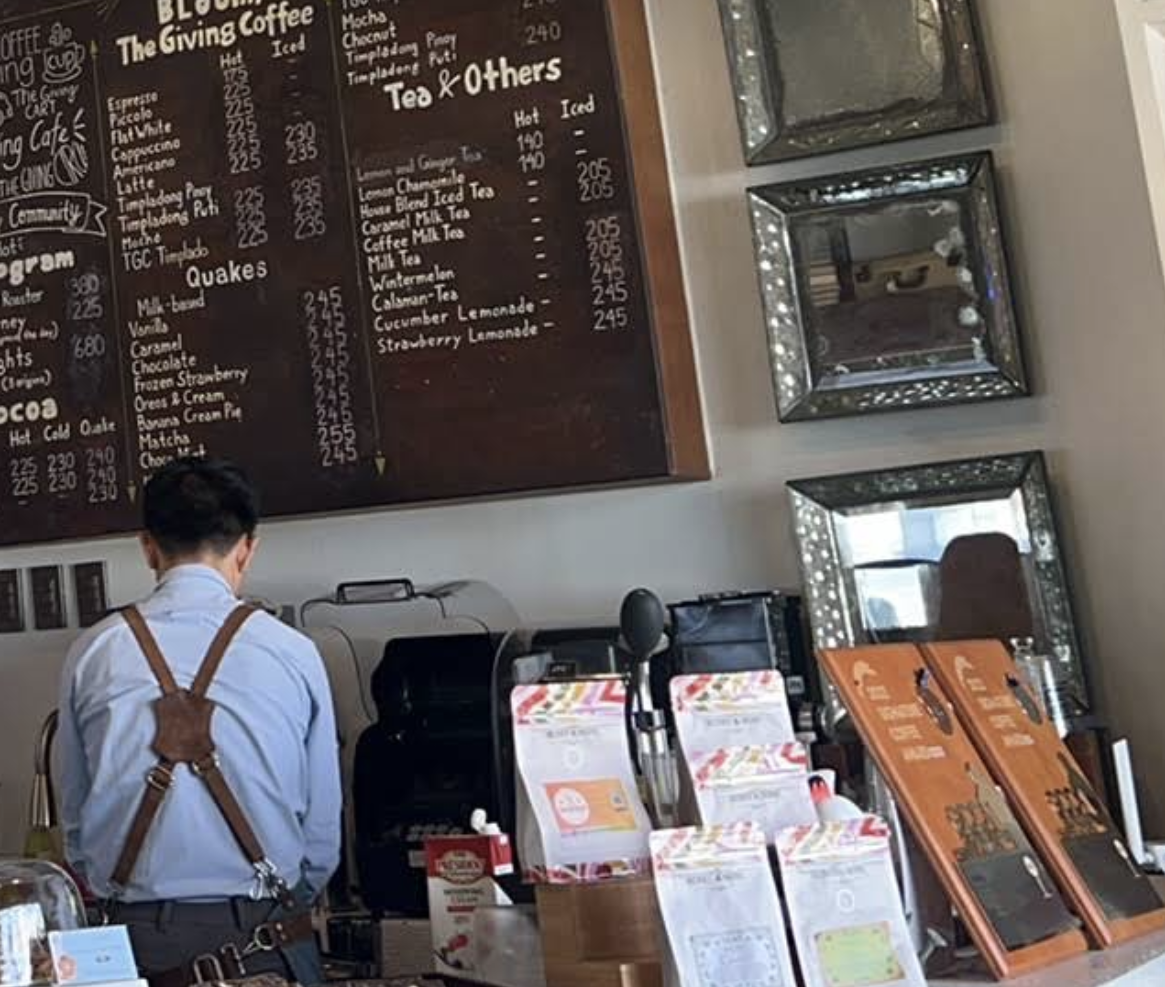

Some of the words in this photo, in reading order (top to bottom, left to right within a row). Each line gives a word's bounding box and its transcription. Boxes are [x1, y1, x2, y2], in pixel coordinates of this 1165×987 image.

[343, 10, 387, 30] Mocha
[116, 35, 157, 66] The
[158, 21, 236, 54] Giving
[239, 1, 313, 36] Coffee
[527, 22, 561, 44] 240
[271, 33, 306, 58] Iced
[384, 81, 432, 110] Tea
[465, 57, 561, 95] Others
[108, 91, 158, 113] Espresso
[514, 107, 539, 129] Hot
[561, 97, 595, 119] Iced
[30, 112, 70, 155] Cafe
[135, 120, 171, 138] White
[113, 158, 176, 180] Americano
[117, 177, 154, 195] Latte
[396, 194, 429, 213] Blend
[434, 189, 464, 207] Iced
[469, 182, 494, 199] Tea
[9, 200, 82, 228] Community
[362, 215, 410, 236] Caramel
[415, 209, 443, 226] Milk
[447, 205, 470, 221] Tea
[363, 237, 408, 253] Coffee
[412, 228, 439, 245] Milk
[444, 224, 465, 240] Tea
[123, 249, 152, 270] TGC
[368, 255, 395, 273] Milk
[399, 251, 421, 267] Tea
[186, 260, 267, 288] Quakes
[369, 264, 455, 293] Wintermelon
[374, 311, 449, 332] Cucumber
[458, 296, 534, 322] Lemonade
[129, 317, 168, 338] Vanilla
[378, 333, 461, 354] Strawberry
[468, 319, 537, 343] Lemonade
[131, 334, 182, 358] Caramel
[132, 352, 196, 375] Chocolate
[135, 377, 174, 393] Frozen
[177, 365, 248, 387] Strawberry
[184, 390, 225, 404] Cream
[185, 408, 222, 423] Cream
[9, 429, 31, 447] Hot
[43, 424, 70, 442] Cold
[139, 430, 190, 450] Matcha
